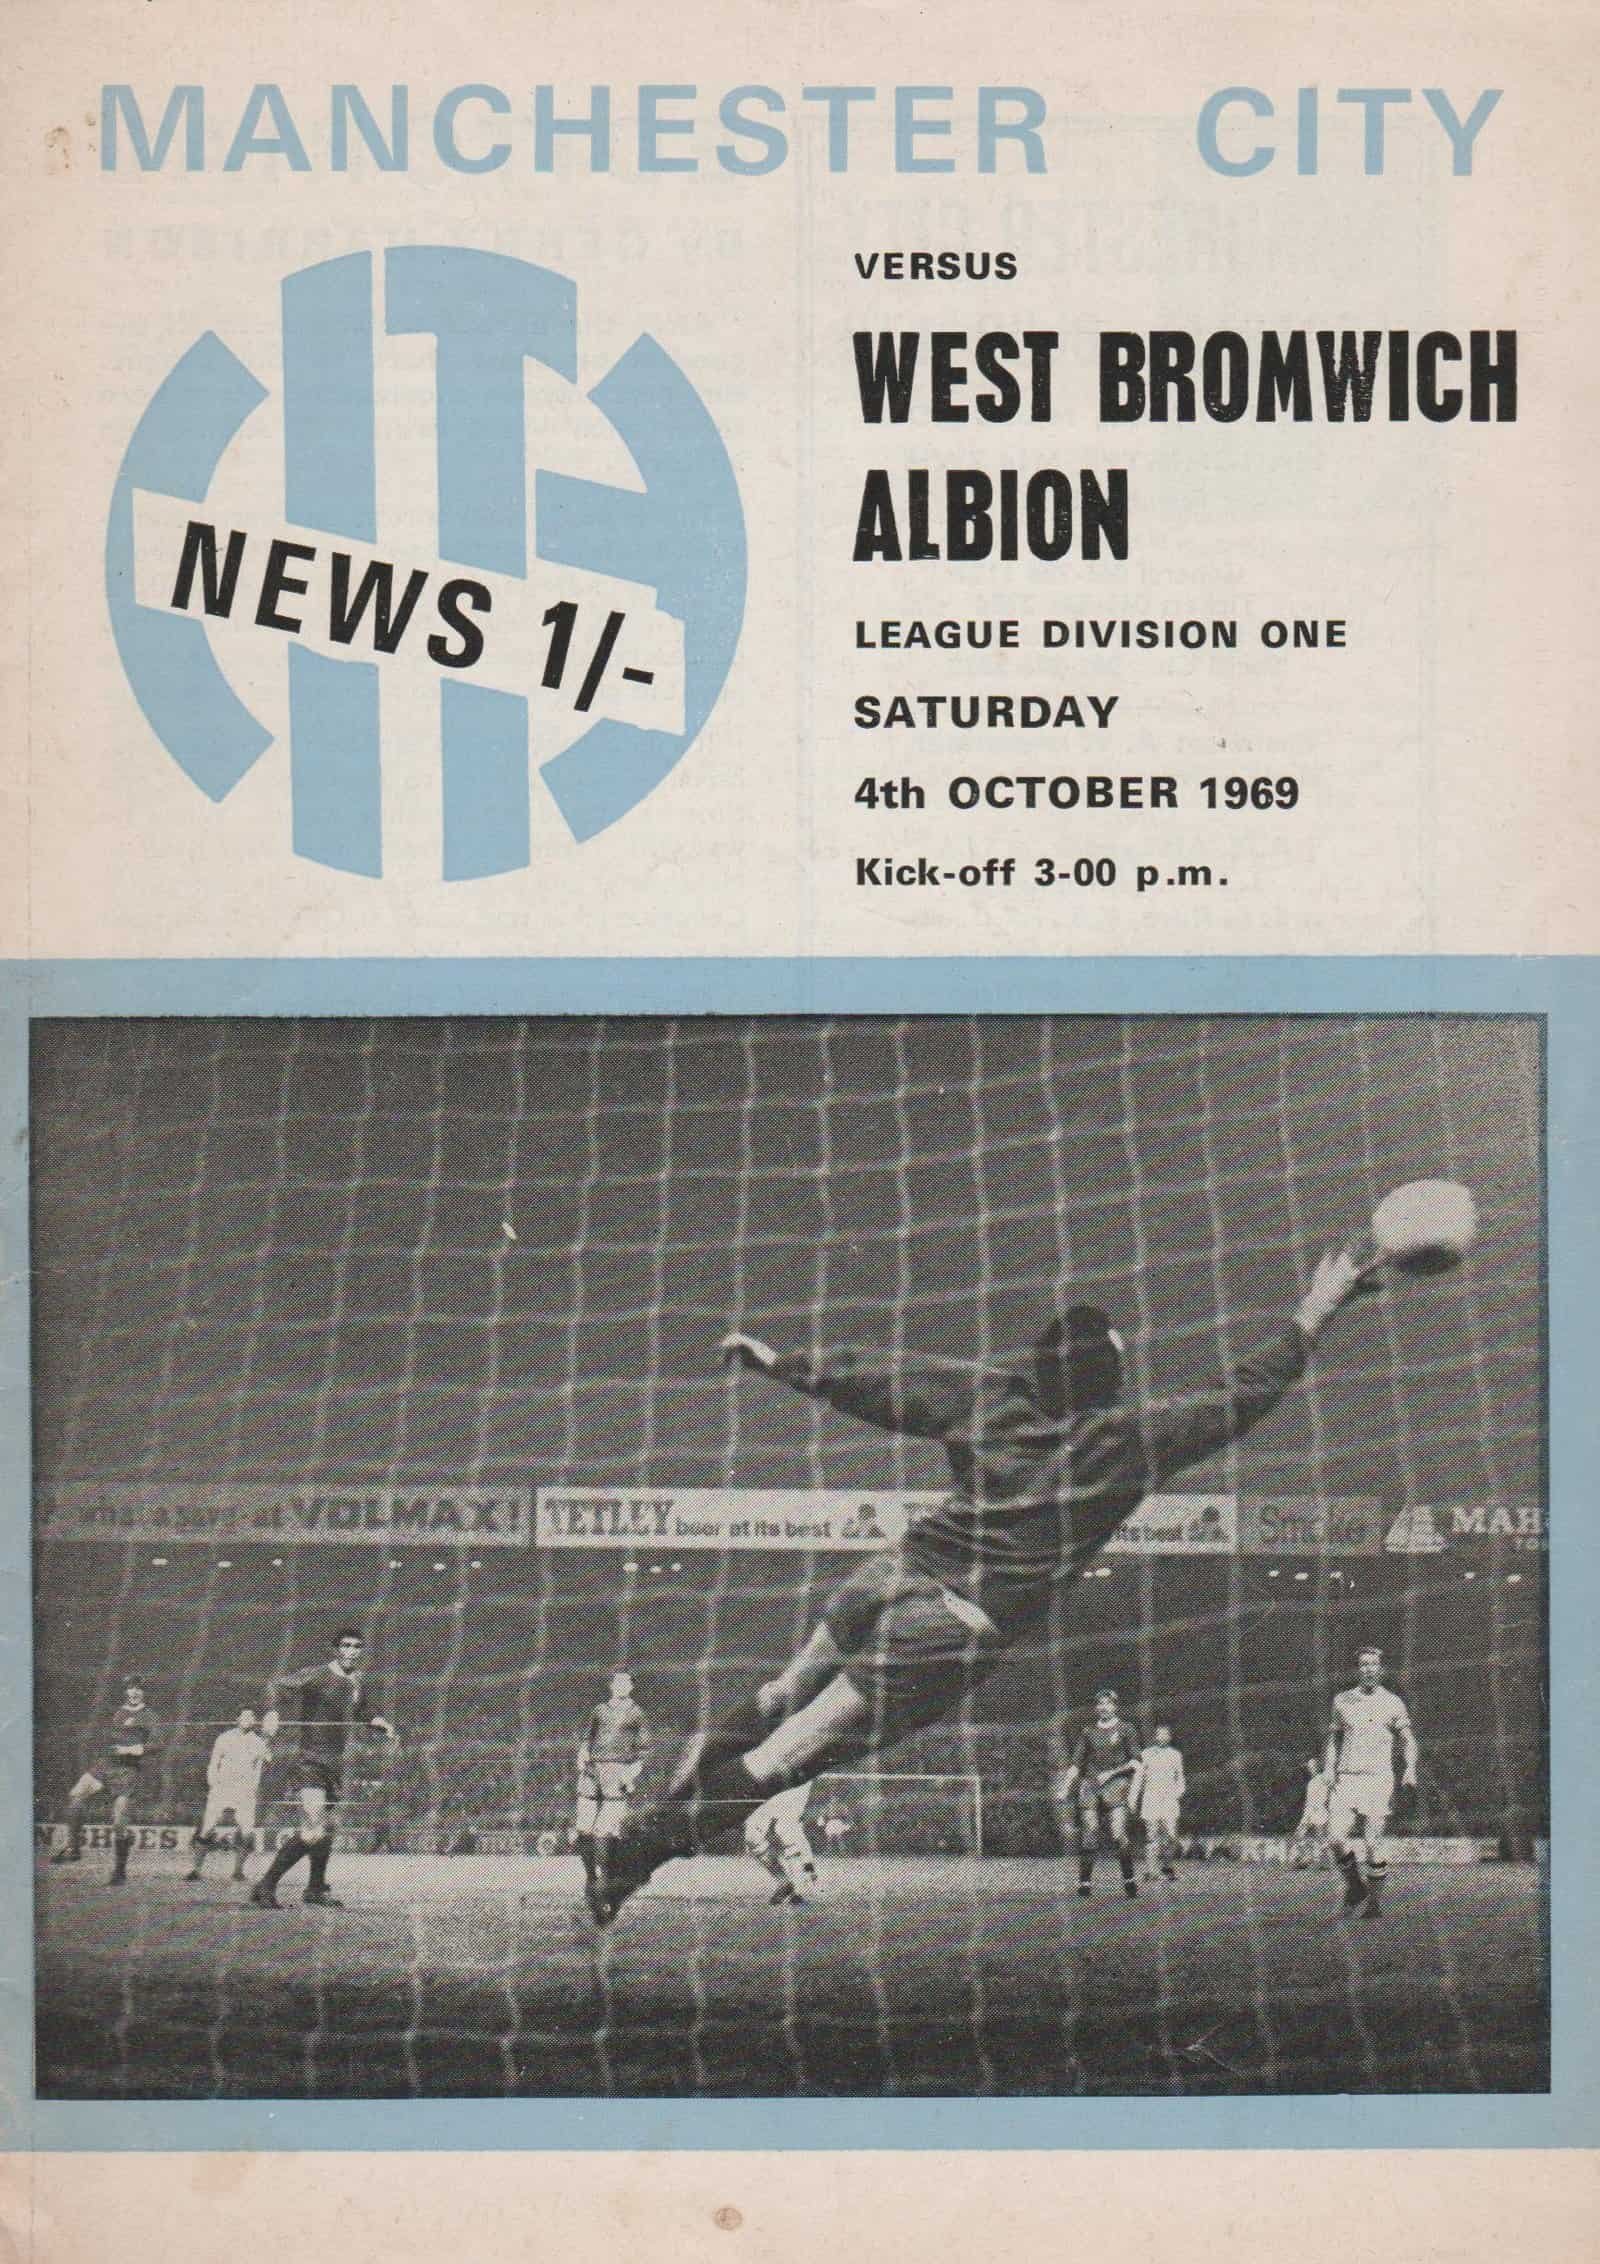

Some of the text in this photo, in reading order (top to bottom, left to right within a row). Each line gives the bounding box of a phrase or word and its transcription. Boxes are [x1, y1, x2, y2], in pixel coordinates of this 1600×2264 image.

[103, 85, 1504, 176] MANCHESTER CITY
[855, 253, 1018, 280] VERSUS
[853, 330, 1518, 423] WEST BROMWICH
[854, 469, 1128, 562] ALBION
[171, 520, 654, 713] NEWS 1/-
[856, 620, 1346, 649] LEAGUE DIVISION ONE
[854, 695, 1119, 729] SATURDAY
[854, 776, 1299, 810] 4th OCTOBER 1969
[856, 858, 1228, 892] Kick-off 3-00 p.m.
[545, 1498, 674, 1536] TETLEY
[785, 1520, 832, 1539] best
